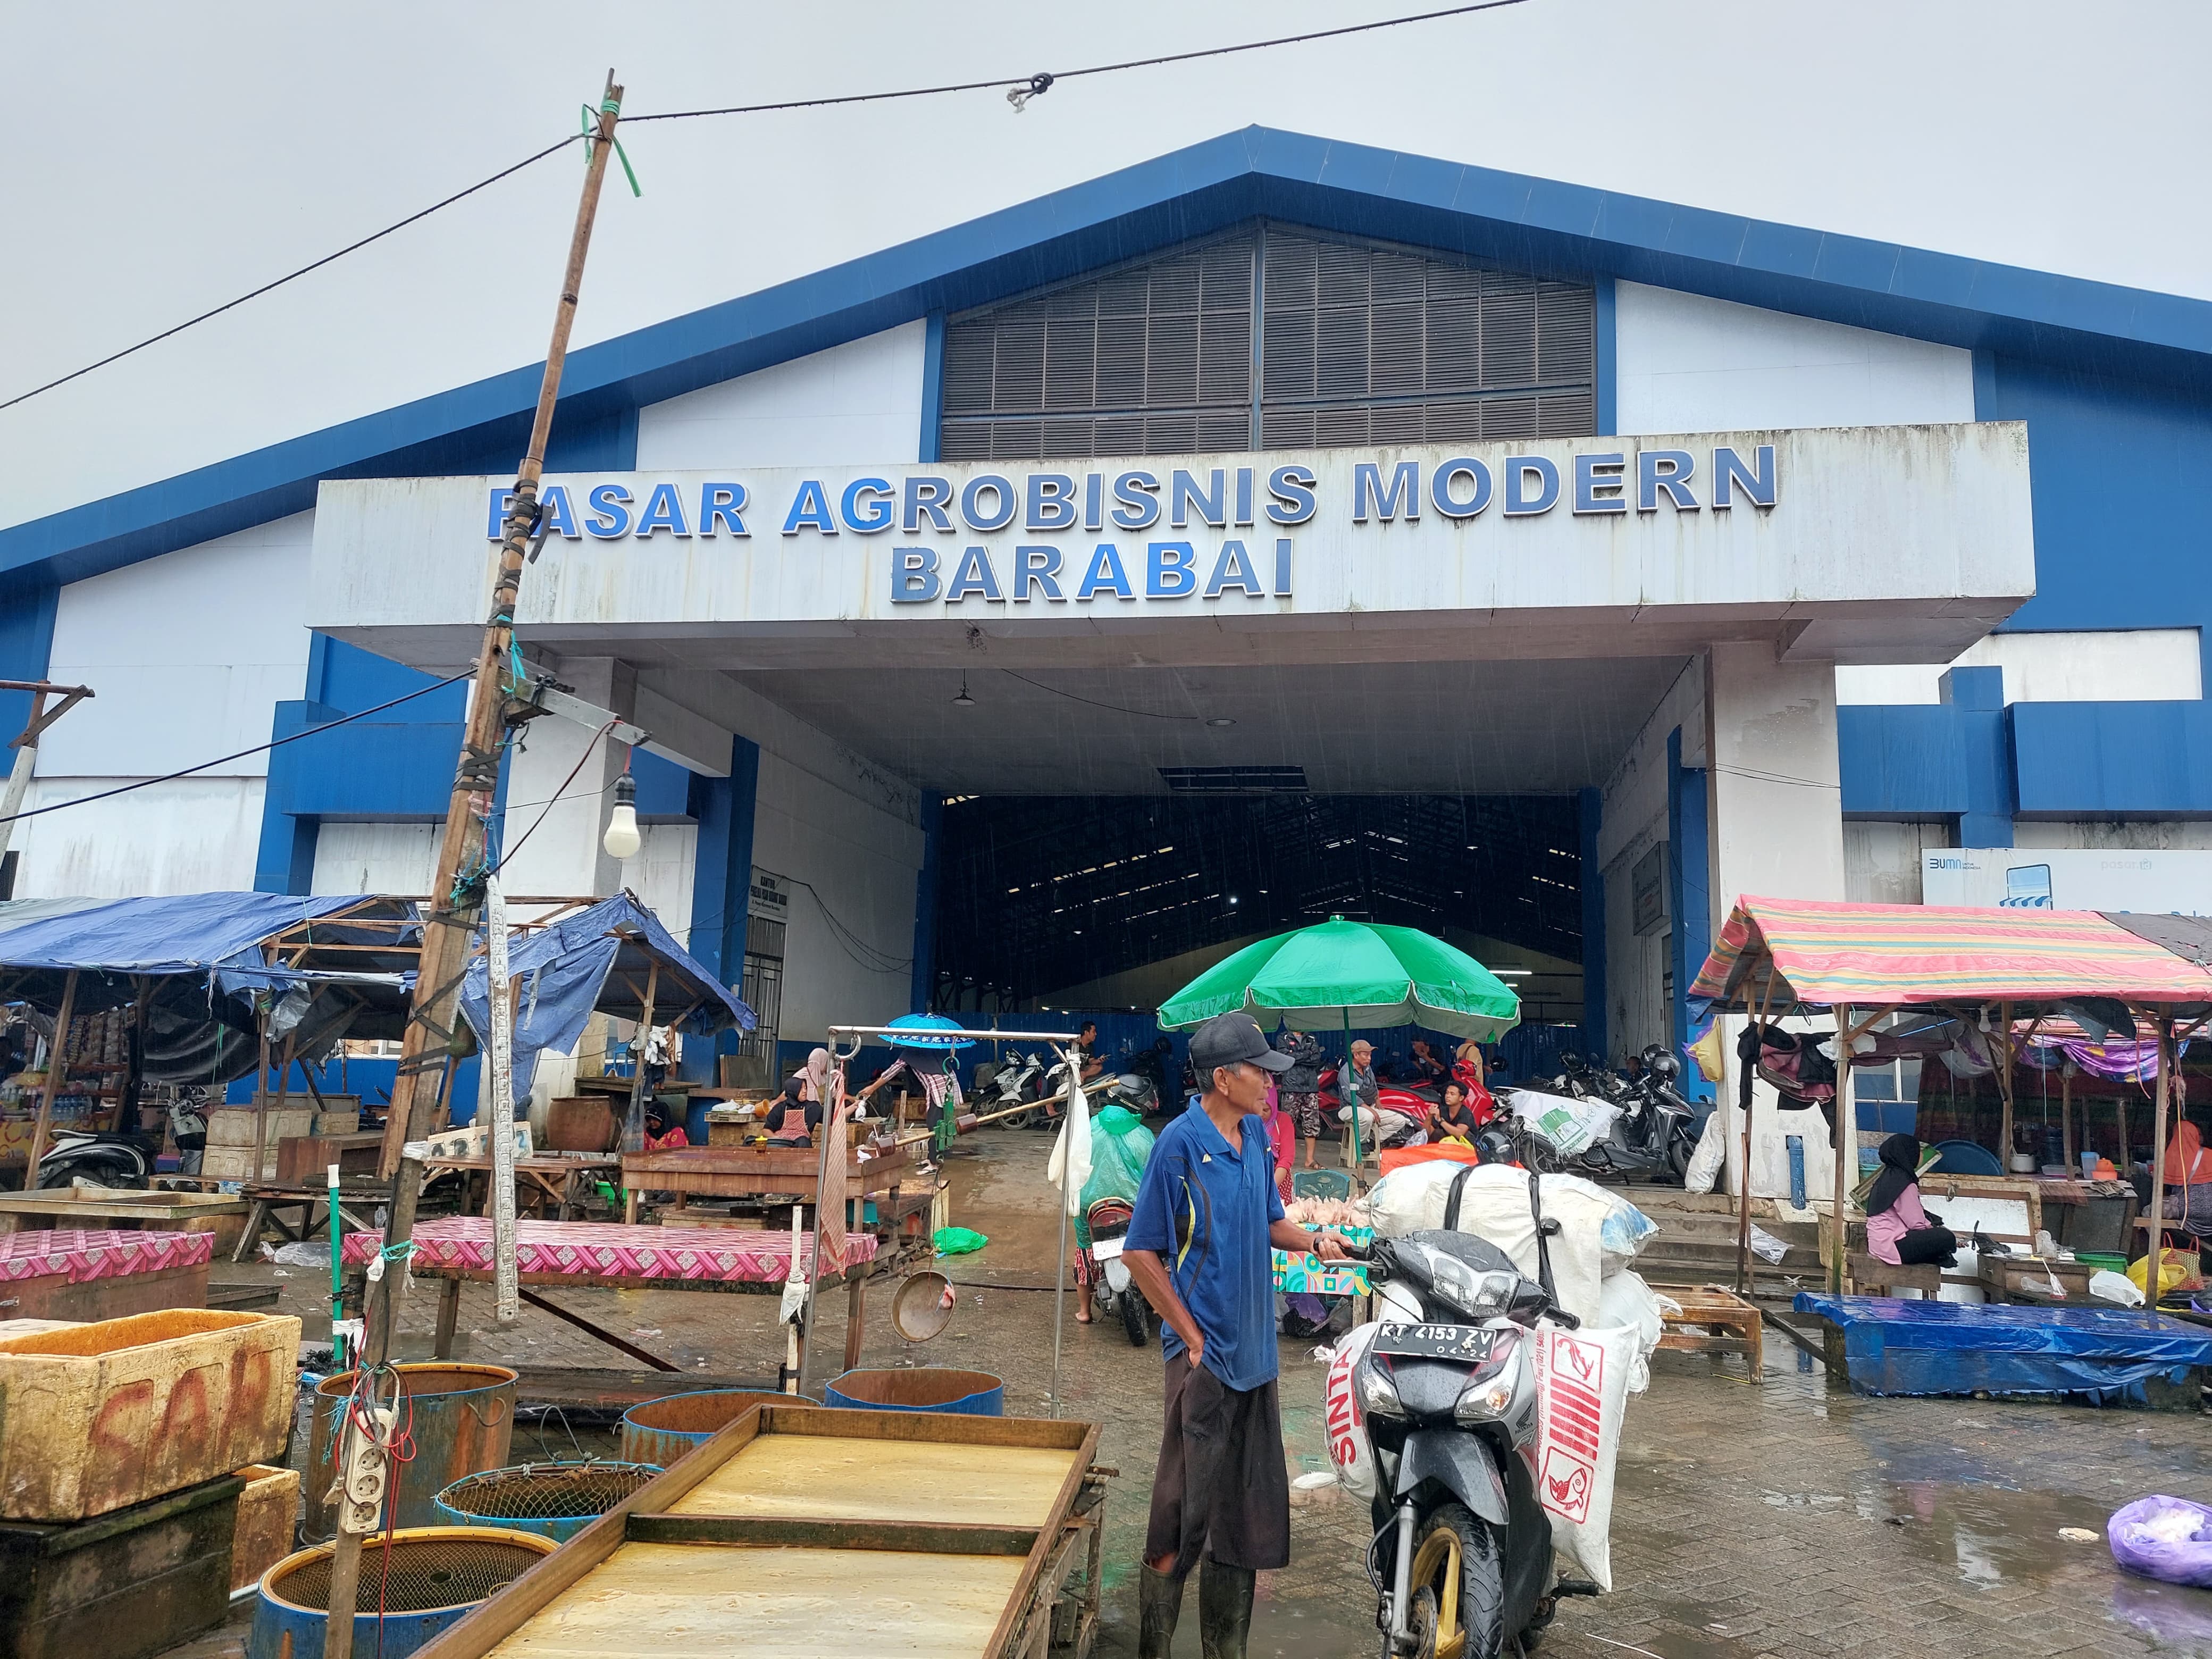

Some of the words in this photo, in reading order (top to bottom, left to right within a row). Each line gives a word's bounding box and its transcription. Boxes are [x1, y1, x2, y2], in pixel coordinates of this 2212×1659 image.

[486, 481, 751, 542] PASAR
[780, 464, 1318, 535] AGROBISNIS
[1353, 445, 1777, 523] MODERN
[890, 537, 1294, 604] BARABAI
[1381, 1324, 1407, 1337] KT
[1414, 1326, 1458, 1341] 4153
[1328, 1346, 1356, 1467] SINTA
